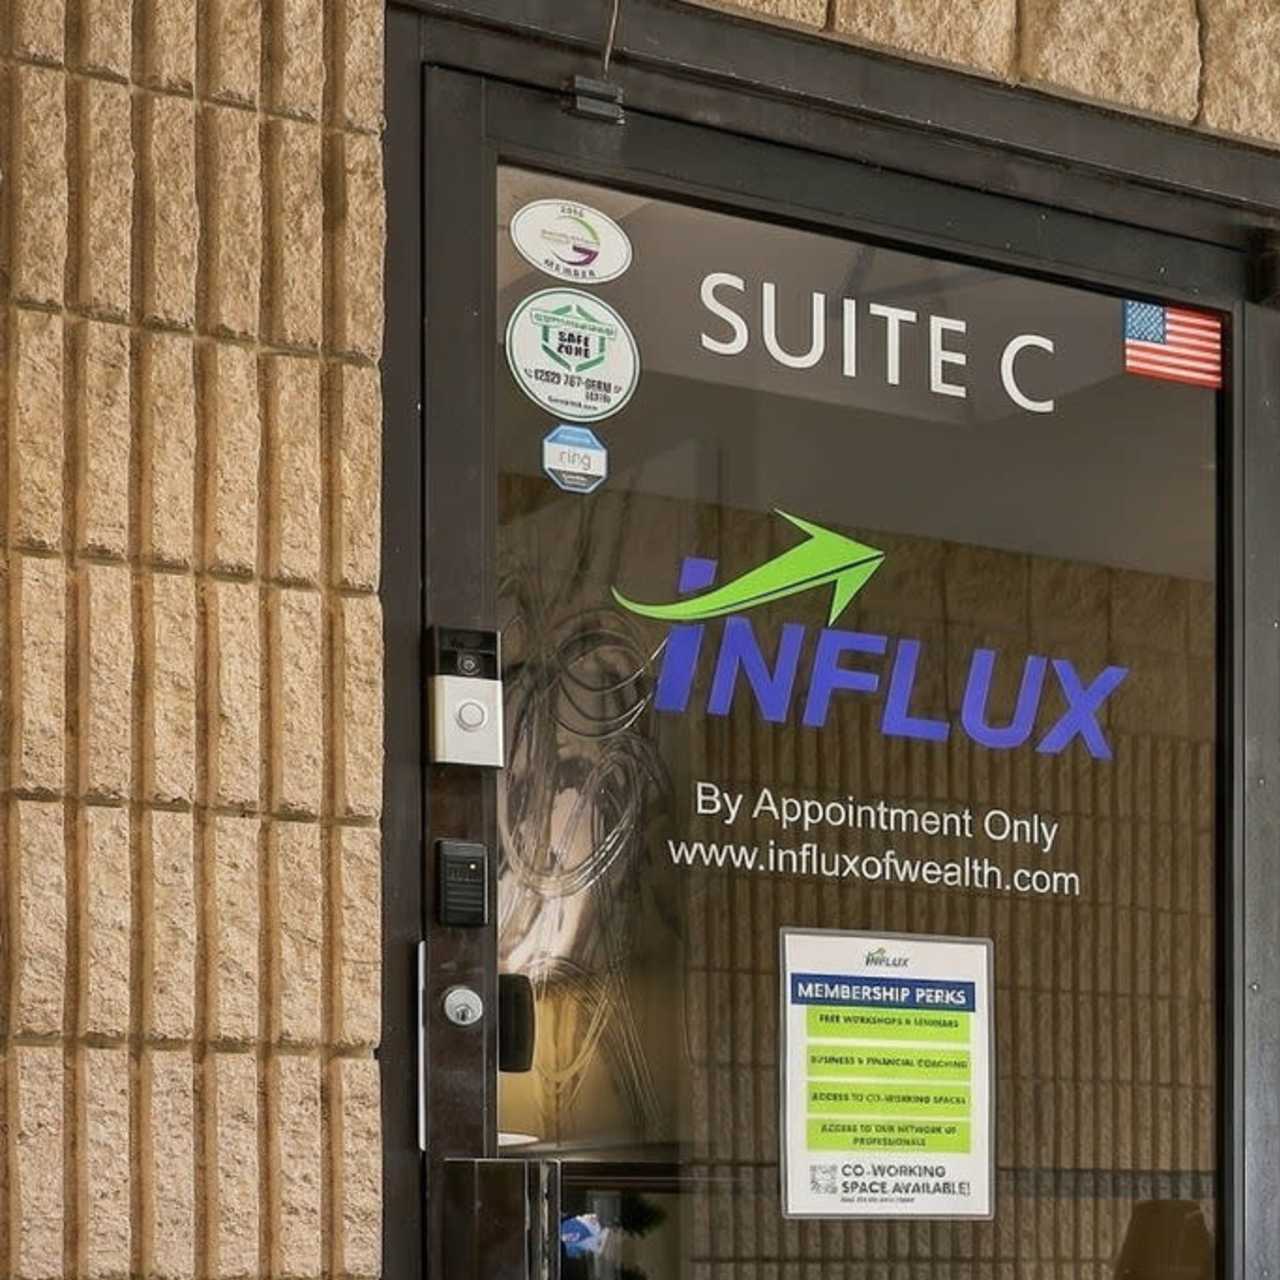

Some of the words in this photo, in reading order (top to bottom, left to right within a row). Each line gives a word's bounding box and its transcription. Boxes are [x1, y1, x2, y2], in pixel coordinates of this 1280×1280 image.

[557, 331, 590, 345] SAFE
[700, 272, 967, 398] SUITE
[1000, 335, 1055, 413] C
[556, 344, 591, 358] ZONE
[560, 448, 591, 471] ring
[695, 782, 743, 824] By
[752, 786, 973, 838] Appointment
[983, 809, 1058, 850] Only
[668, 836, 1081, 896] www.influxofwealth.com
[798, 982, 910, 1002] MEMBERSHIP
[915, 987, 966, 1004] PERKS
[819, 1014, 840, 1023] FREE
[843, 1015, 903, 1026] WORKSHOPS
[810, 1055, 855, 1065] BUSINESS
[866, 1056, 914, 1067] FINANCIAL
[917, 1060, 968, 1069] COACHING
[811, 1092, 849, 1102] ACCESS
[851, 1093, 863, 1102] TO
[821, 1124, 857, 1133] ACCESS
[860, 1124, 872, 1133] TO
[841, 1163, 946, 1178] CO-WORKING
[841, 1181, 887, 1194] SPACE
[892, 1182, 971, 1196] AVAILABLE!
